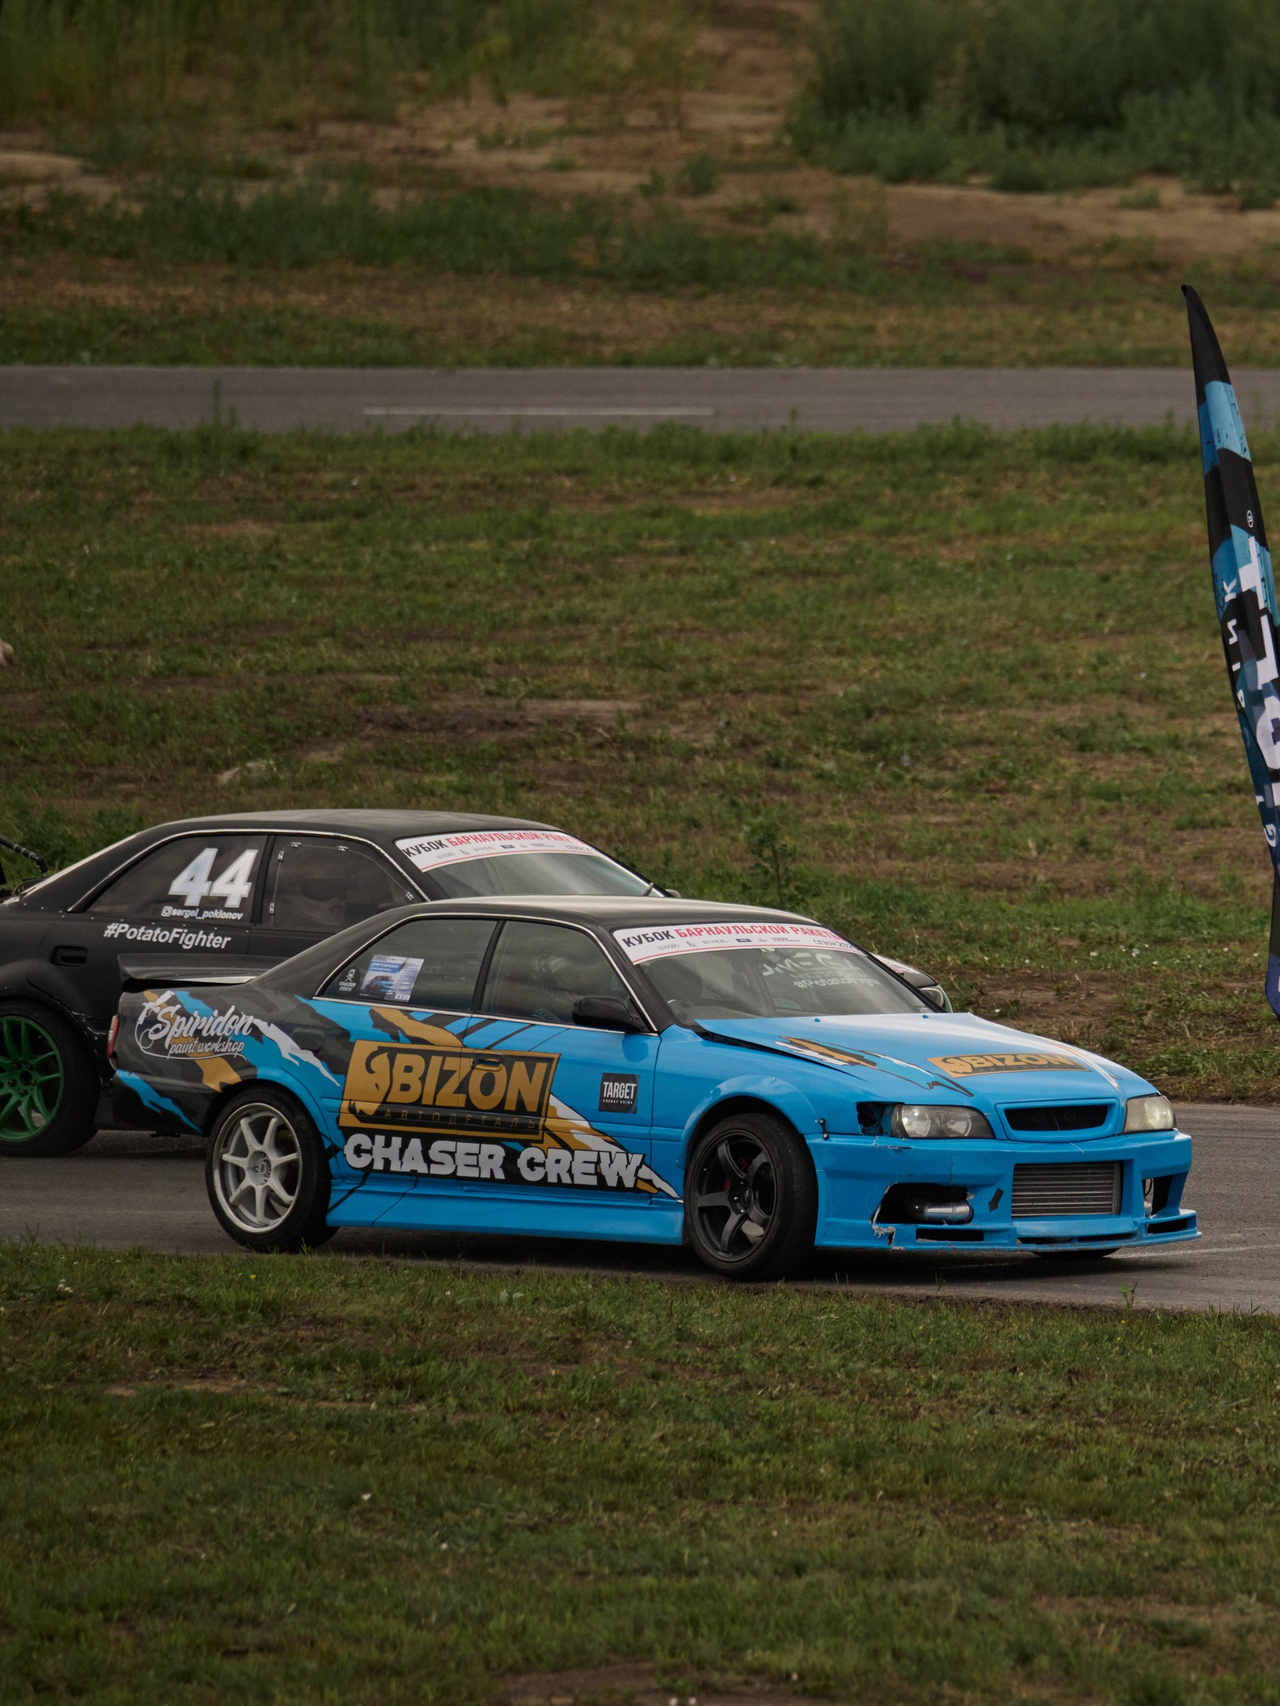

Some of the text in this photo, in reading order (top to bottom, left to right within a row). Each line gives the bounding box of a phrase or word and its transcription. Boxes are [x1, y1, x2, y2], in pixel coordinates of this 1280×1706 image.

[401, 839, 448, 857] КУБОК
[445, 831, 540, 847] БАРНАУЛЬСКОЙ
[168, 847, 259, 908] 44
[103, 922, 231, 950] #PotatoFighter
[622, 930, 675, 948] КУБОК
[674, 924, 790, 939] БАРНАУЛЬСКОЙ
[148, 1004, 254, 1050] Spiridon
[167, 1036, 245, 1060] paint workshop
[970, 1054, 1076, 1068] BIZON
[391, 1052, 549, 1113] BIZON
[603, 1081, 637, 1099] TARGET
[343, 1133, 643, 1188] CHASER CREW
